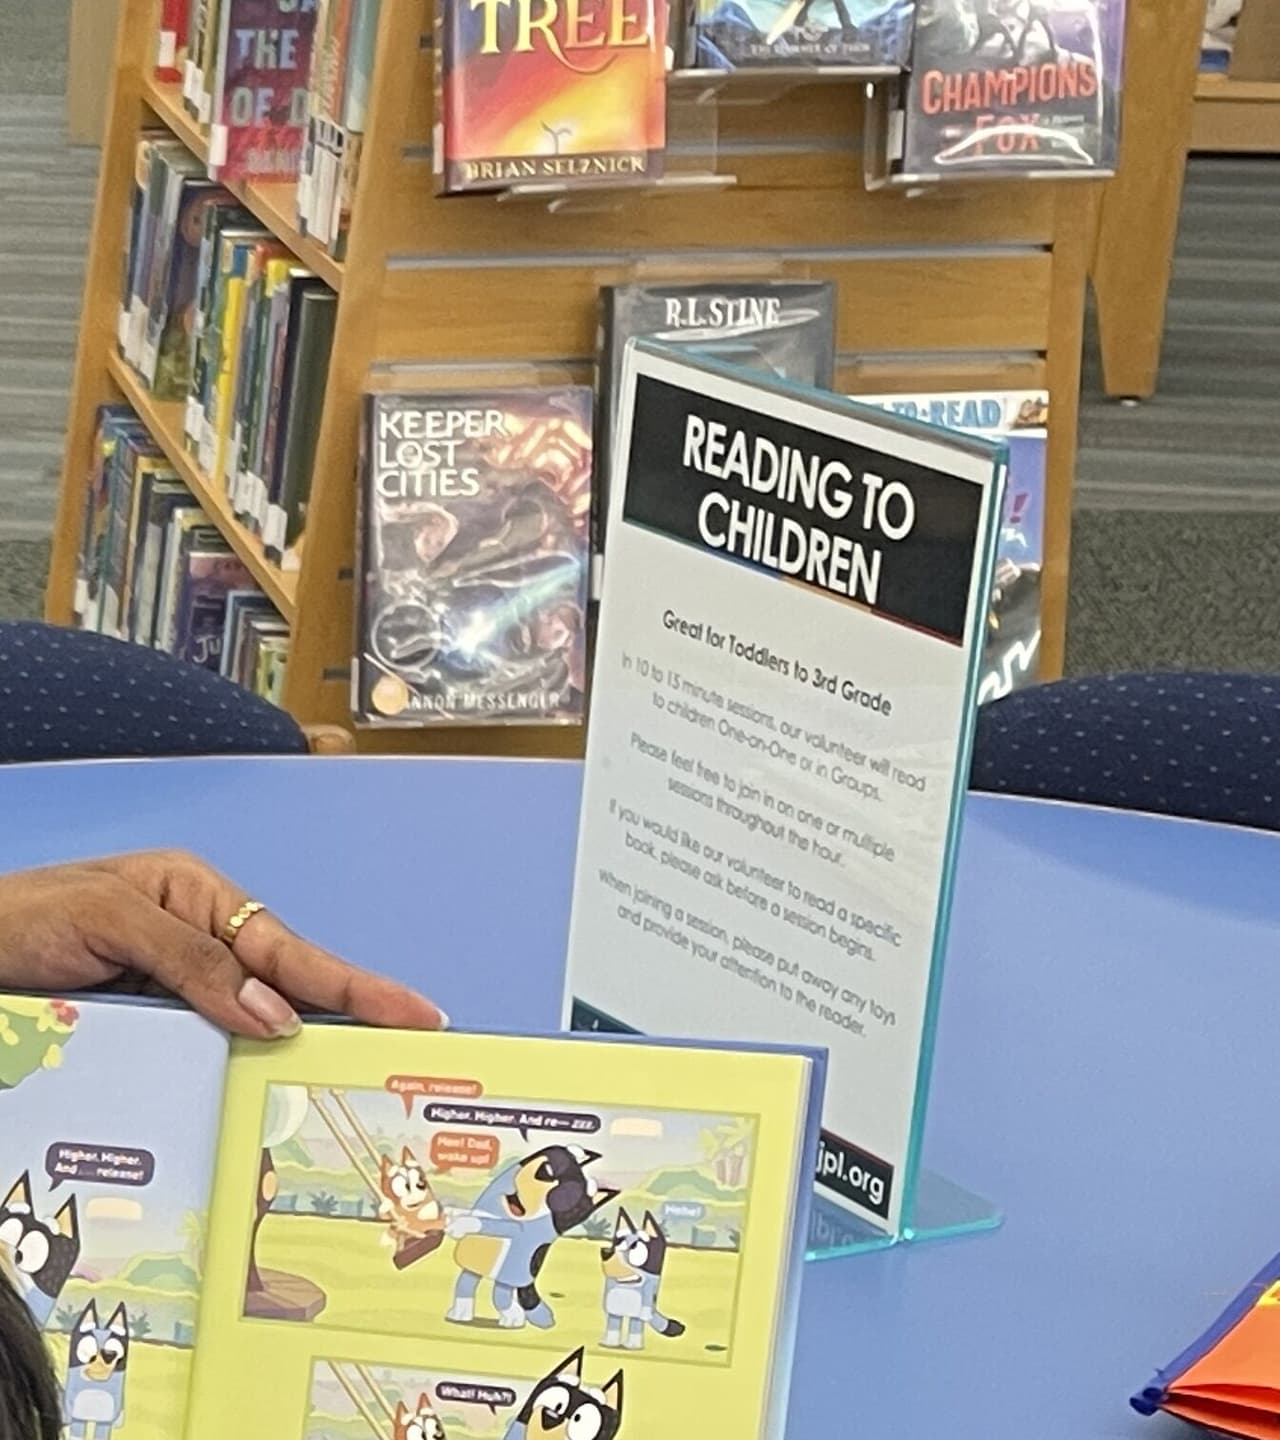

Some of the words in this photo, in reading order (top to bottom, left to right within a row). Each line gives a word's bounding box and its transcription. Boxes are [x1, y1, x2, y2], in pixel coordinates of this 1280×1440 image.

[235, 29, 300, 70] THE
[470, 0, 649, 75] TREE
[231, 86, 274, 128] OF
[921, 63, 1098, 115] CHAMPIONS
[465, 161, 536, 180] BRIAN
[543, 155, 646, 176] SELZNICK
[379, 440, 466, 469] LOST
[380, 410, 512, 439] KEEPER
[376, 467, 481, 498] CITIES
[683, 414, 854, 519] READING
[862, 472, 916, 541] TO
[698, 492, 883, 605] CHILDREN
[662, 609, 703, 641] Great
[706, 625, 726, 649] for
[729, 634, 790, 676] Toddlers
[794, 659, 809, 683] to
[812, 667, 837, 694] 3rd
[841, 680, 893, 716] Grade
[621, 651, 633, 669] In
[636, 656, 650, 678] 10
[651, 664, 664, 683] to
[667, 670, 681, 690] 15
[682, 679, 724, 709] minute
[780, 721, 802, 739] our
[804, 730, 867, 766] volunteer
[869, 757, 891, 777] will
[892, 767, 926, 792] read
[652, 692, 665, 709] to
[667, 700, 716, 731] children
[718, 718, 797, 766] One-on-One
[800, 755, 813, 772] or
[815, 759, 828, 778] in
[631, 731, 668, 762] Please
[671, 749, 695, 773] feel
[697, 760, 721, 786] free
[723, 773, 736, 793] to
[737, 780, 761, 802] join
[763, 790, 775, 809] in
[777, 800, 794, 819] on
[797, 809, 823, 831] one
[826, 821, 840, 836] or
[842, 828, 896, 863] multiple
[716, 796, 785, 840] throughout
[788, 828, 809, 851] the
[618, 805, 641, 826] you
[643, 816, 679, 844] would
[680, 830, 701, 855] like
[703, 845, 724, 864] our
[726, 854, 785, 892] volunteer
[788, 880, 801, 900] to
[803, 890, 836, 916] read
[837, 907, 848, 922] a
[850, 912, 903, 948] specific
[660, 850, 702, 880] please
[703, 869, 724, 890] ask
[726, 878, 769, 911] before
[770, 902, 781, 917] a
[783, 907, 827, 938] session
[617, 904, 642, 927] and
[643, 917, 690, 950] provide
[691, 939, 718, 963] your
[719, 955, 777, 993] attention
[780, 982, 793, 1001] to
[796, 989, 817, 1013] the
[632, 884, 673, 921] joining
[674, 908, 685, 922] a
[732, 936, 775, 966] please
[777, 958, 799, 977] put
[801, 970, 839, 1001] away
[841, 989, 868, 1014] any
[869, 999, 896, 1027] toys
[519, 1114, 542, 1127] And
[54, 1162, 78, 1175] And
